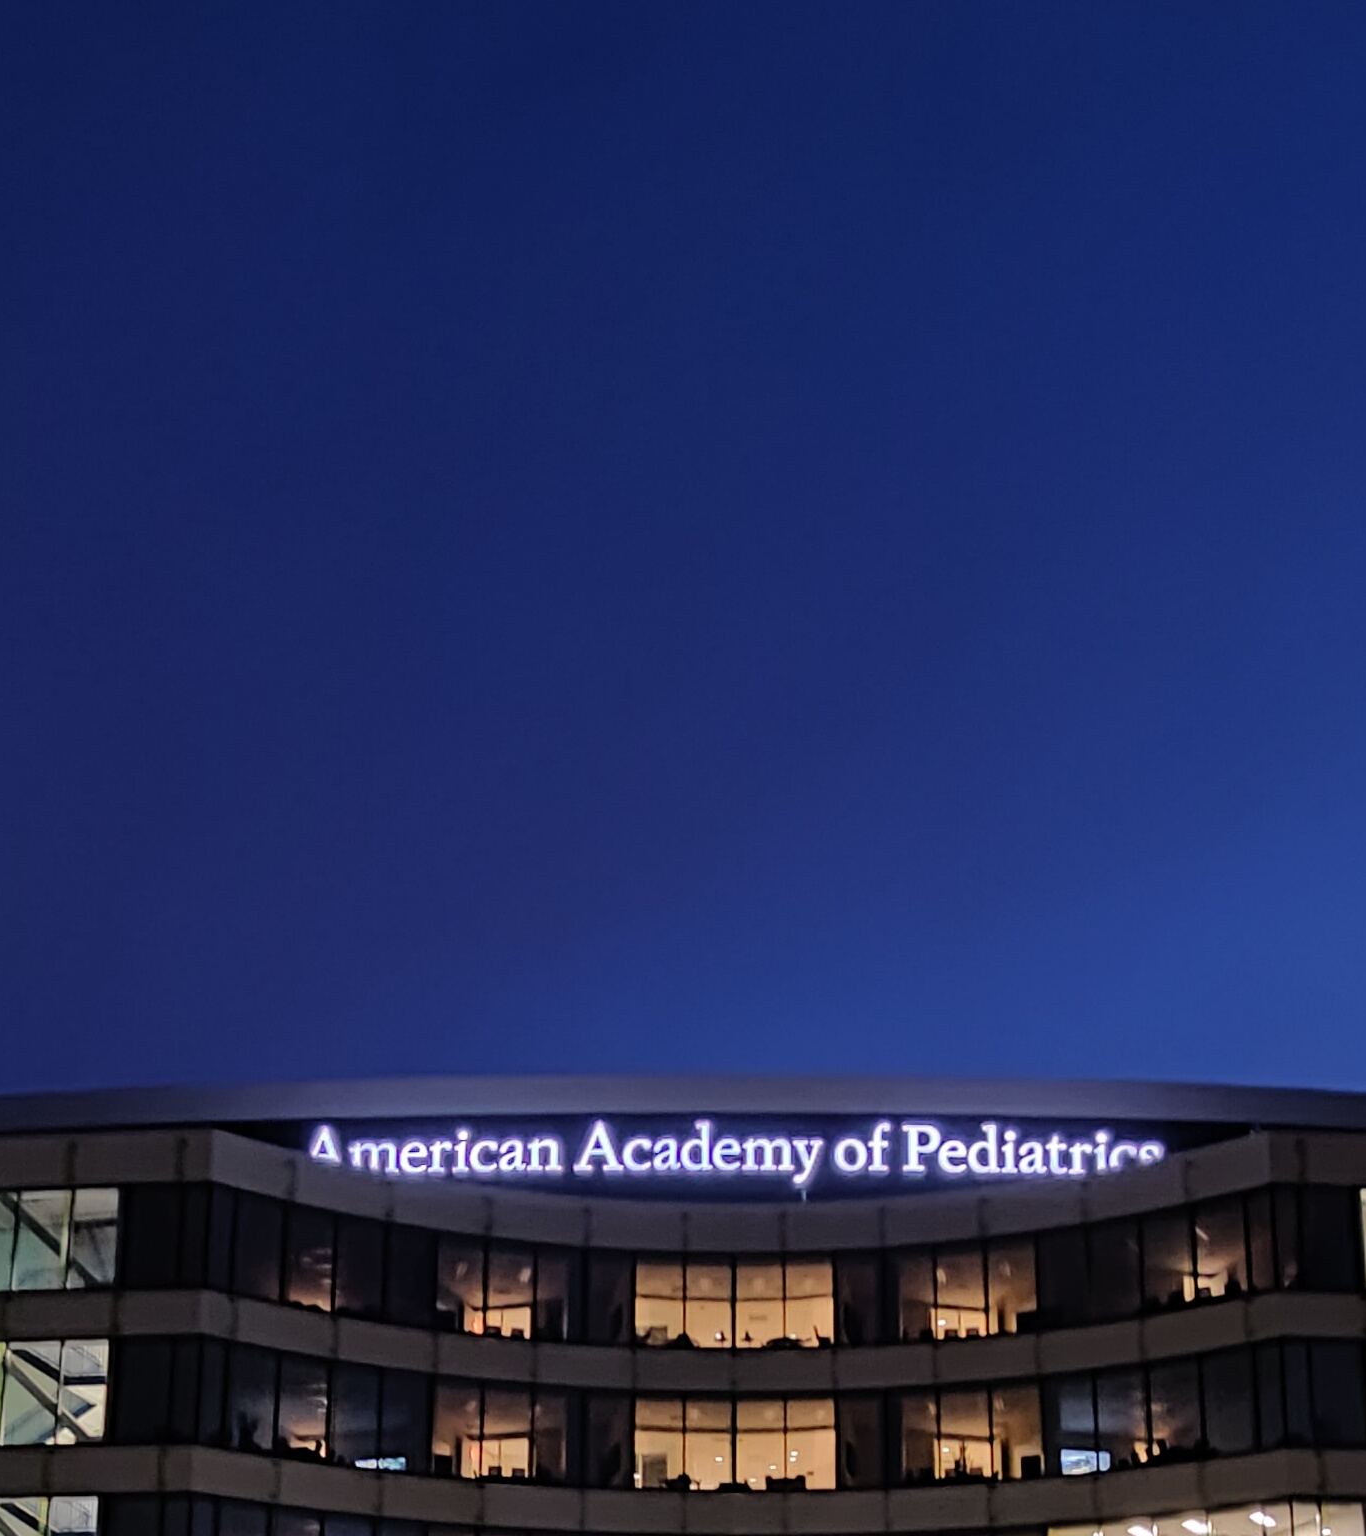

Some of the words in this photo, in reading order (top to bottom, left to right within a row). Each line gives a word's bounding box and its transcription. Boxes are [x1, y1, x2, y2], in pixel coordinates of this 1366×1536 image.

[311, 1125, 563, 1175] American
[573, 1119, 823, 1184] Academy
[835, 1120, 891, 1172] of
